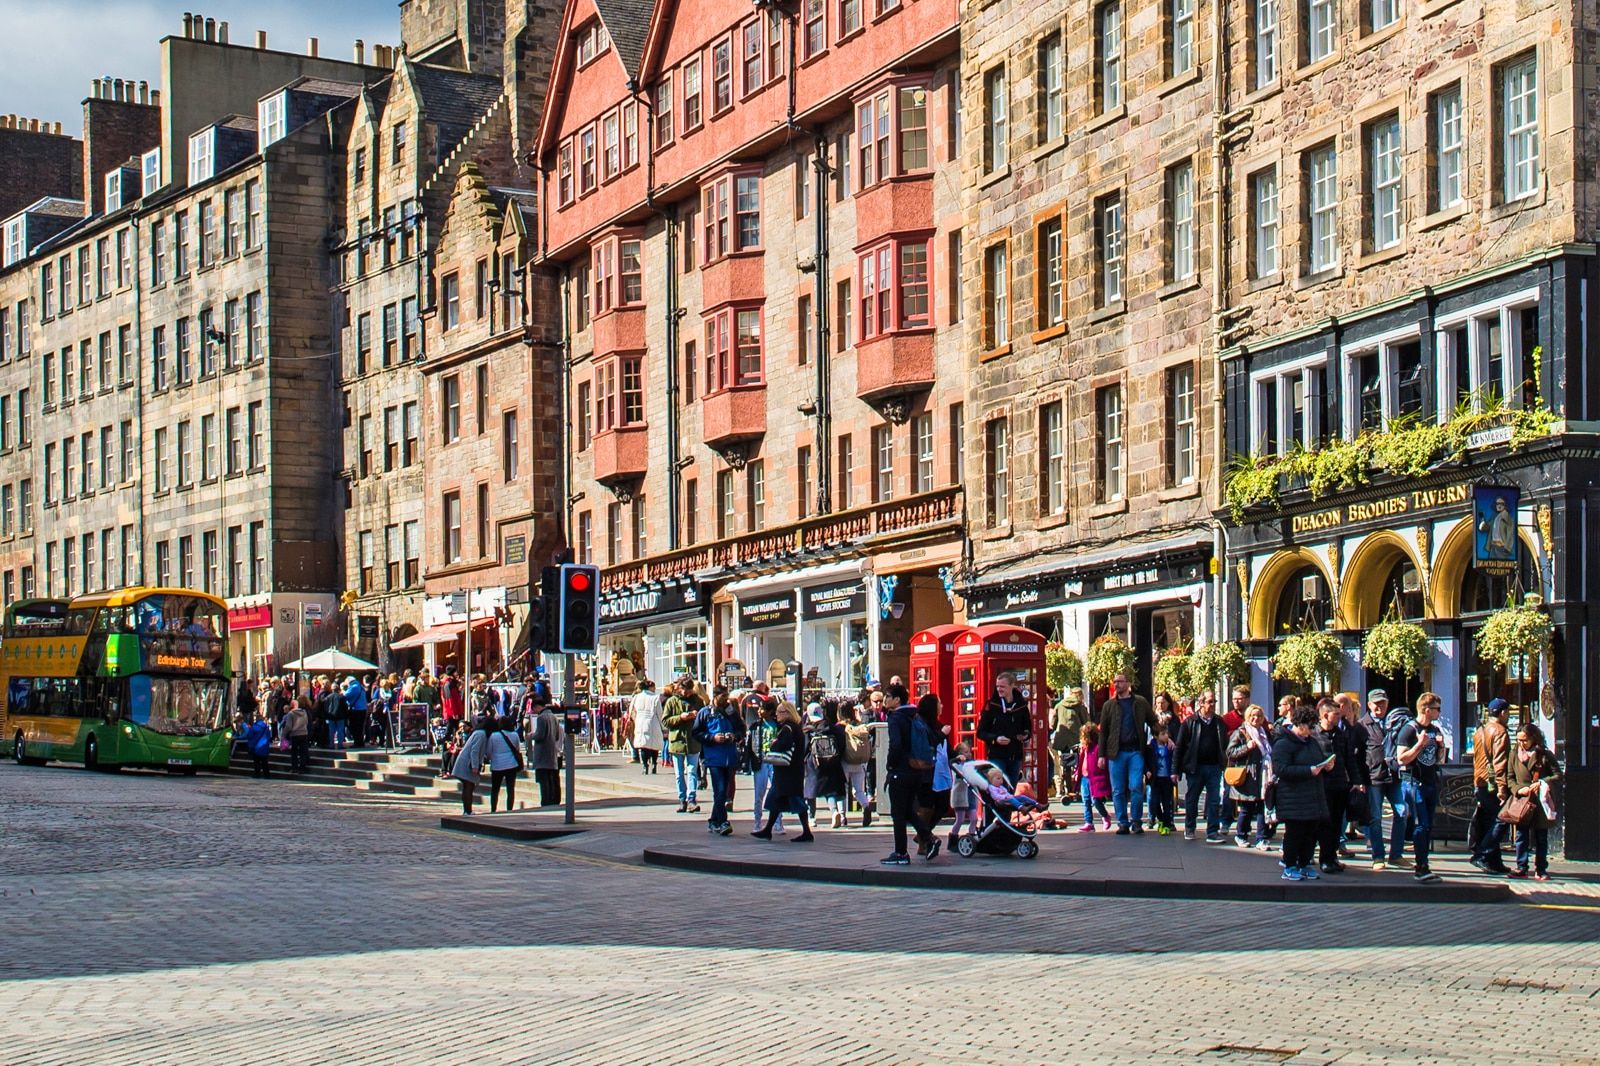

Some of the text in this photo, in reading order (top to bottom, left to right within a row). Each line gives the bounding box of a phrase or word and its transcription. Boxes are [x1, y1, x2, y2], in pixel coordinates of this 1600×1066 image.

[1292, 484, 1468, 533] DEACON BRODIE'S TAVERN
[610, 591, 657, 617] SCOTLAND
[752, 613, 769, 622] FACTORY
[992, 644, 1037, 652] TELEPHONE
[157, 654, 206, 668] Edinburgh Tour
